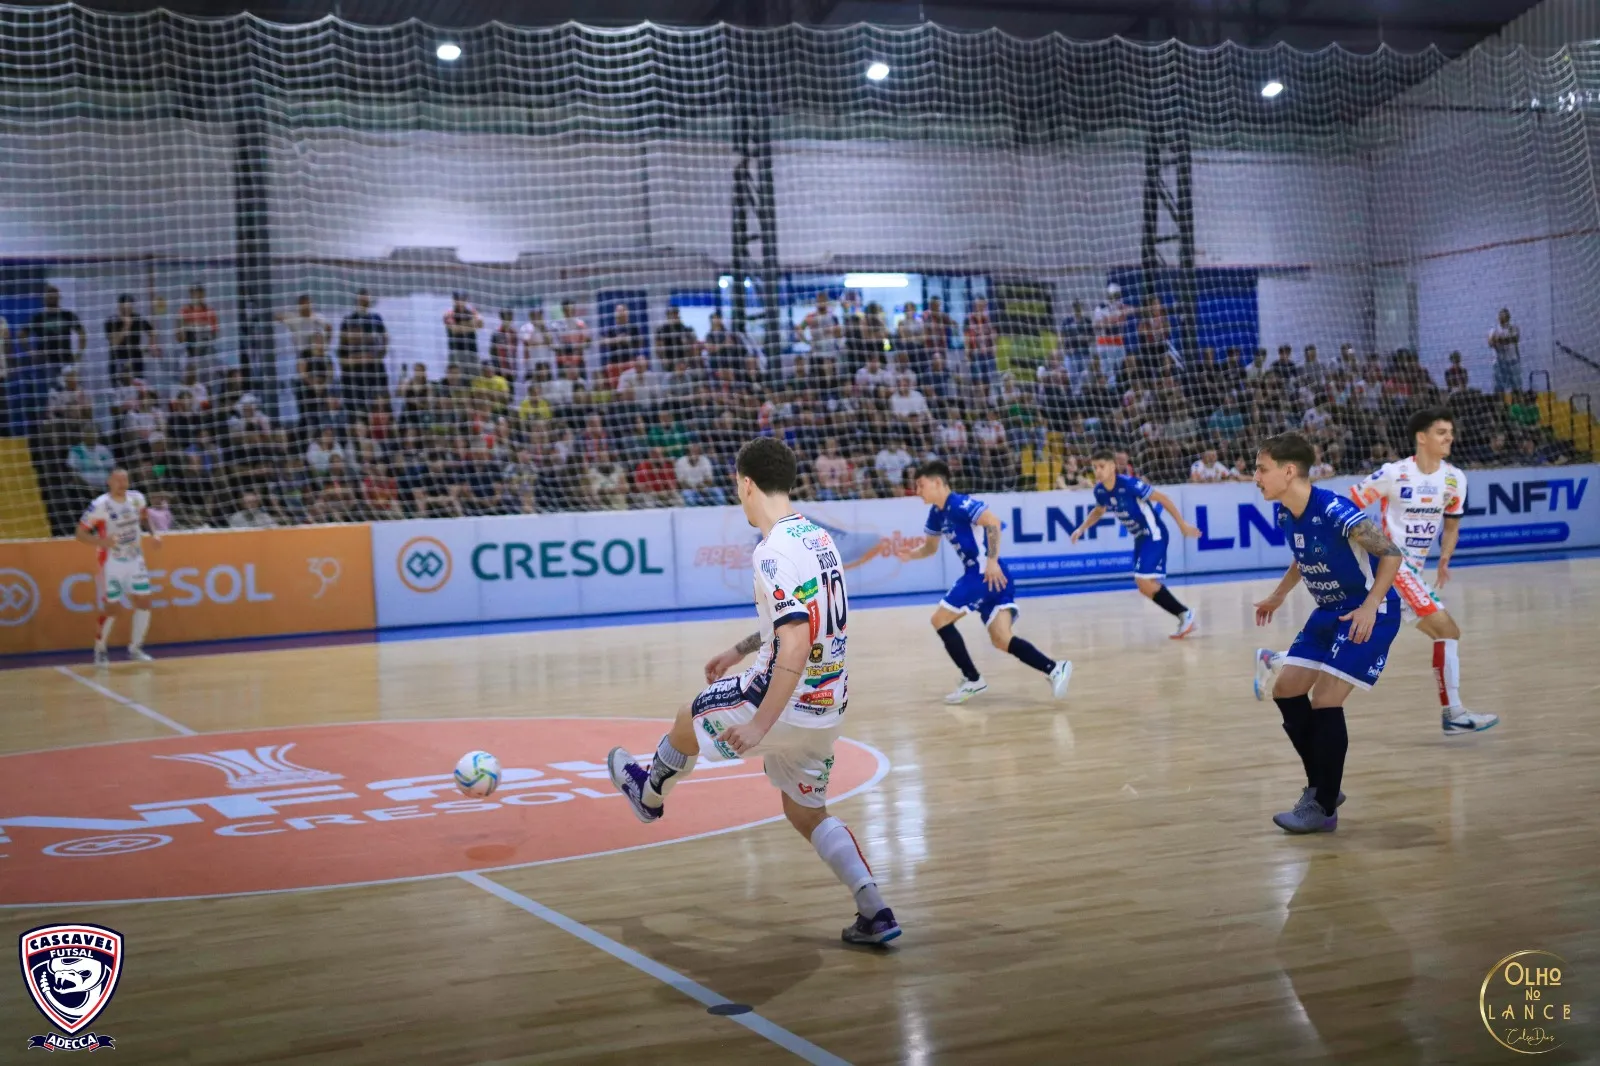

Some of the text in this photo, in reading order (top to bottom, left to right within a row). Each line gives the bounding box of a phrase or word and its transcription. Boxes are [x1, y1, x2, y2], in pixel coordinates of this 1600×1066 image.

[1406, 521, 1437, 534] LEVO
[471, 538, 663, 581] CRESOL
[821, 569, 848, 637] 10
[1331, 642, 1340, 659] 4
